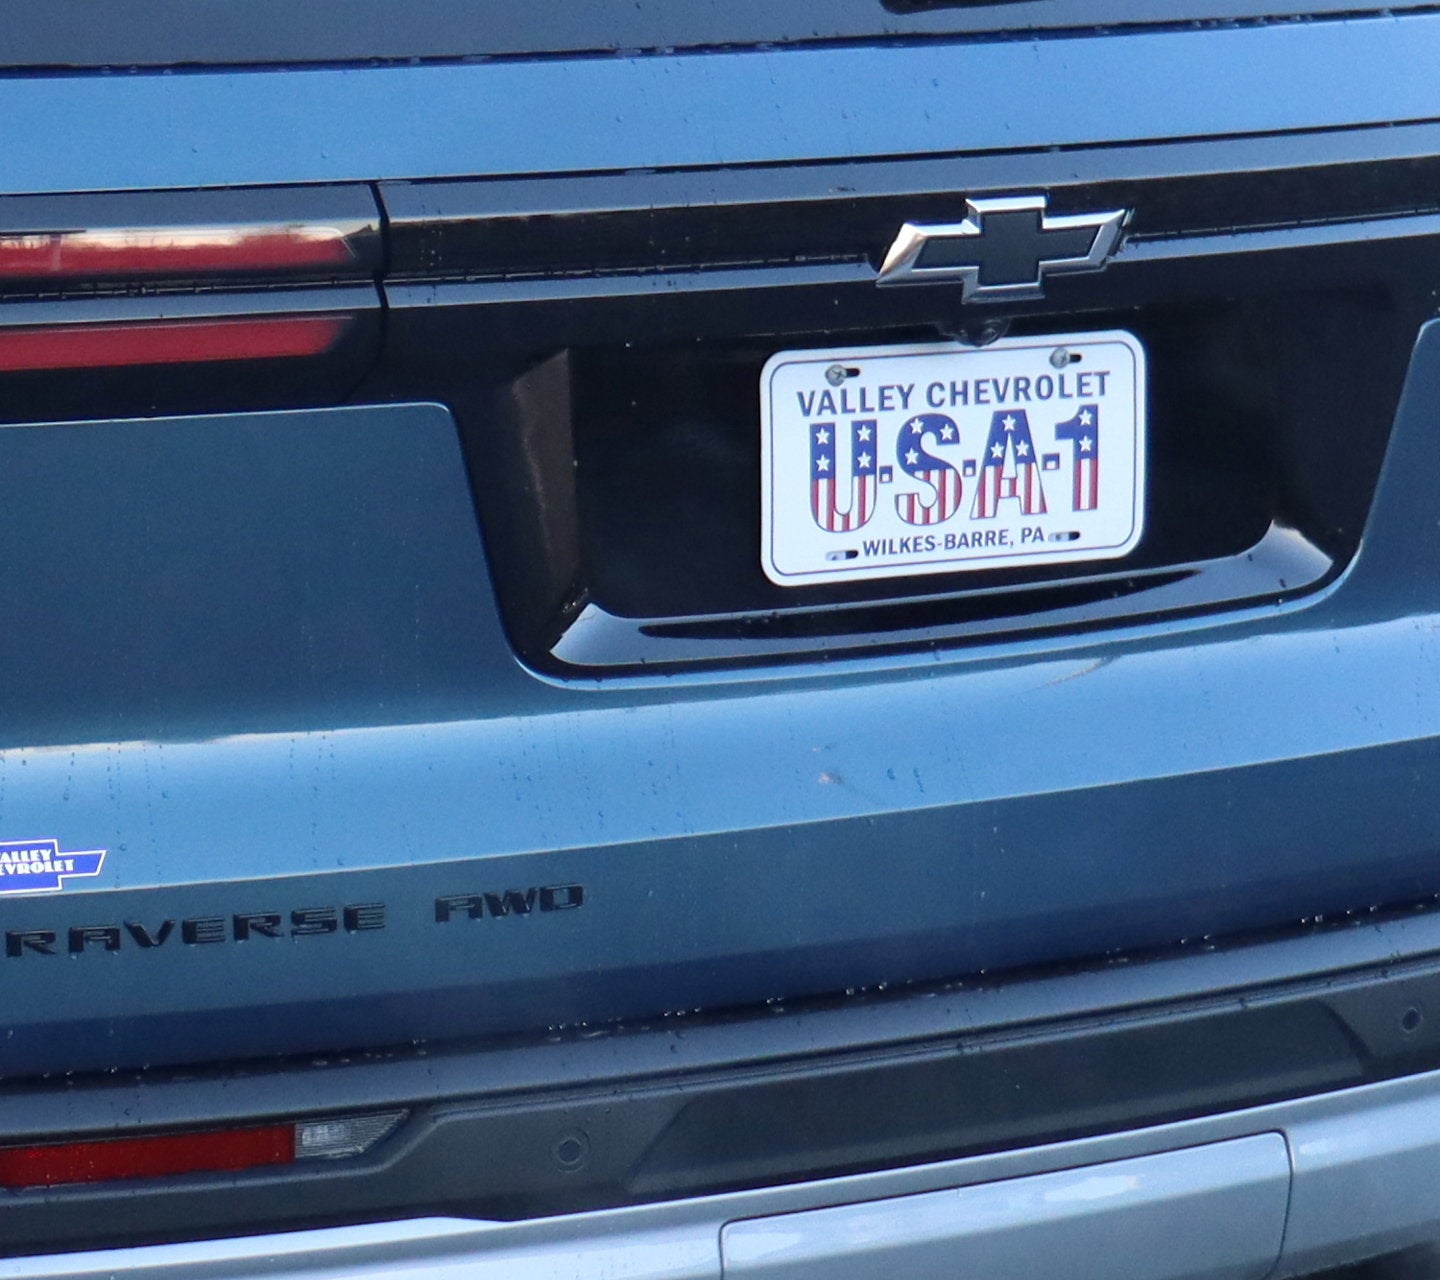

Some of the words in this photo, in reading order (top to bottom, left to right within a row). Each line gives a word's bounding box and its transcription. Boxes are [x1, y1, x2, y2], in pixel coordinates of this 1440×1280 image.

[796, 383, 916, 417] VALLEY
[925, 371, 1111, 408] CHEVROLET
[862, 529, 1014, 556] WILKES-BARRE,
[1020, 526, 1046, 545] PA
[434, 883, 585, 923] AWD
